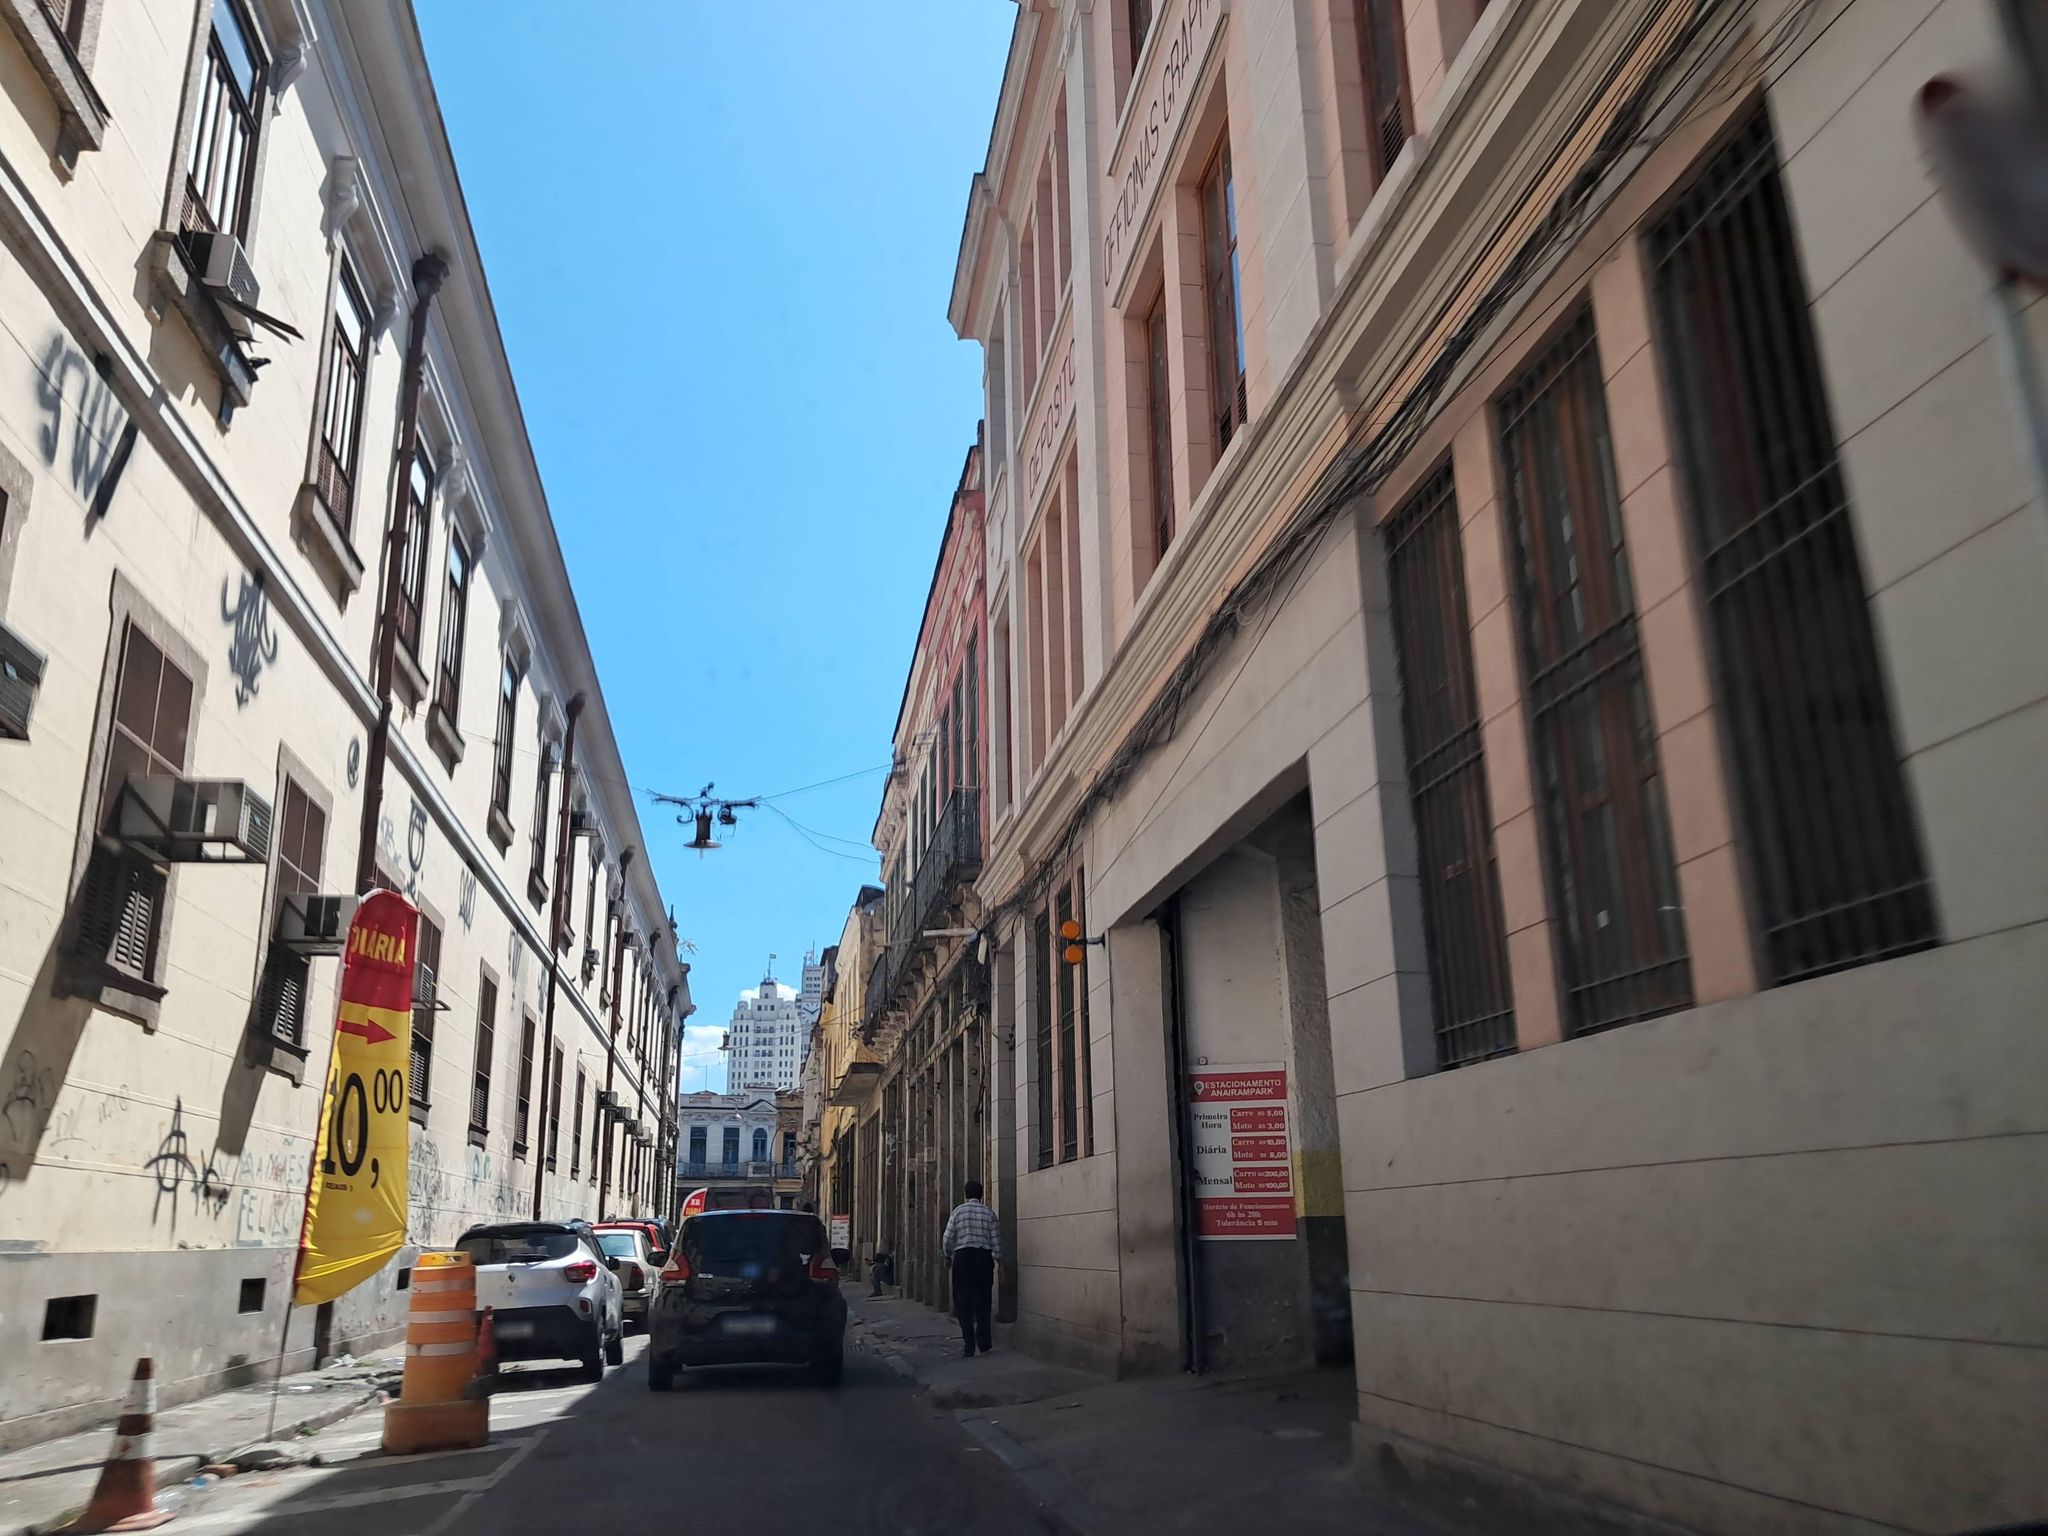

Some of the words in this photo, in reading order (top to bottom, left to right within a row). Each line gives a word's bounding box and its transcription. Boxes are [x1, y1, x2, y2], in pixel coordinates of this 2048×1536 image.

[1103, 101, 1160, 288] OFFICINAS
[1205, 1079, 1281, 1089] ESTACIONAMENTO
[1210, 1087, 1274, 1097] ANAIRAMPARK
[1193, 1112, 1228, 1121] Primeira
[1231, 1109, 1254, 1117] Carro
[1200, 1121, 1222, 1129] Hora
[1232, 1122, 1253, 1130] Moto
[1232, 1138, 1255, 1146] Carro
[1197, 1145, 1227, 1155] Diária
[1233, 1151, 1254, 1159] Moto
[1234, 1170, 1256, 1178] Carro
[1235, 1181, 1256, 1189] Moto
[1216, 1219, 1256, 1227] Tolerância
